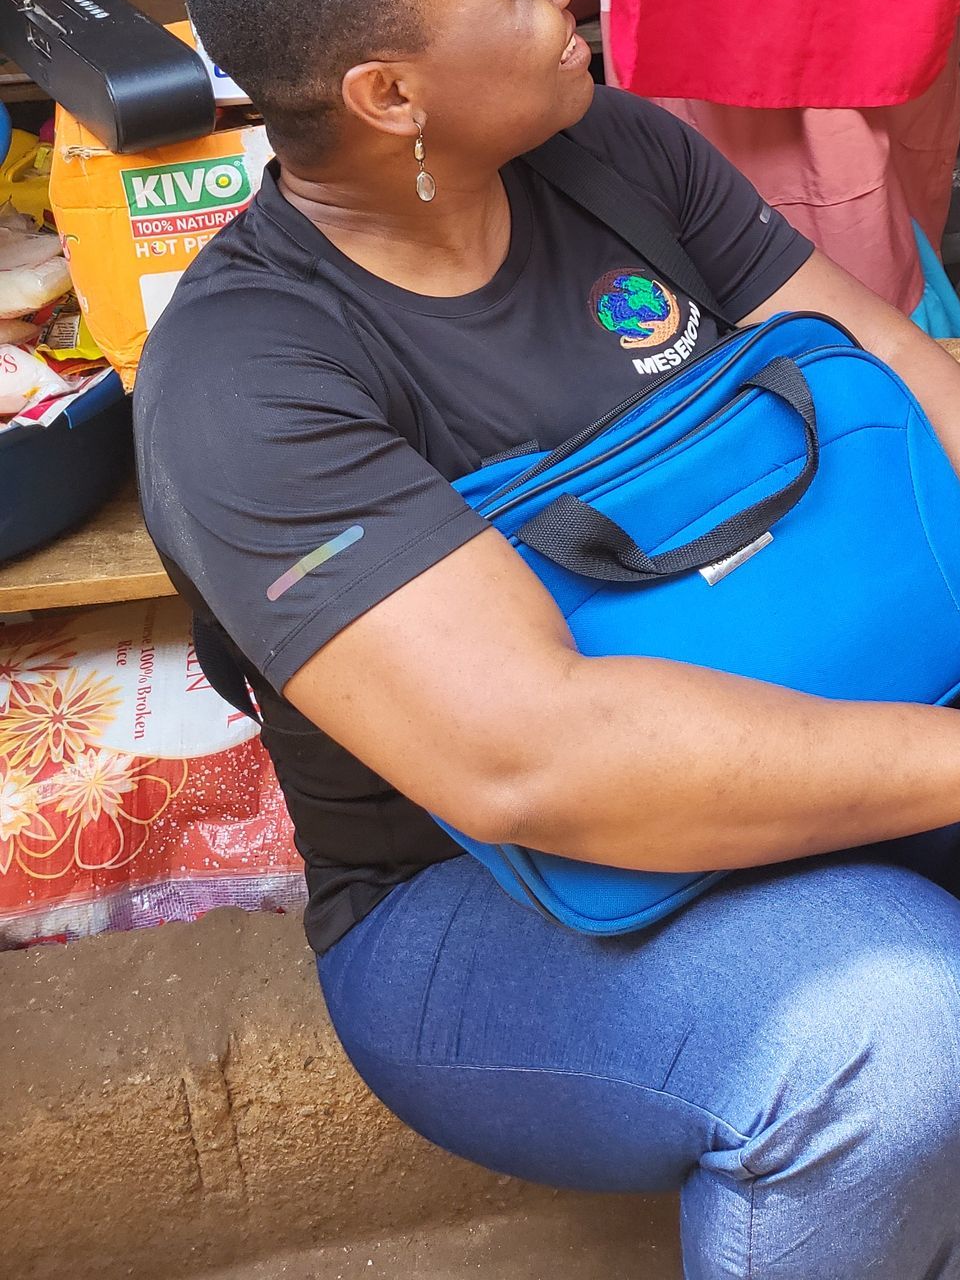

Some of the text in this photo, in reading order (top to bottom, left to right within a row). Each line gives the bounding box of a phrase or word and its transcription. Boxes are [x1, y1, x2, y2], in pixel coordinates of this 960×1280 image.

[131, 164, 243, 209] KIVO
[136, 220, 174, 235] 100%
[135, 238, 178, 258] HOT
[116, 640, 132, 667] Rice
[138, 646, 156, 684] 100%
[134, 685, 152, 740] Broken
